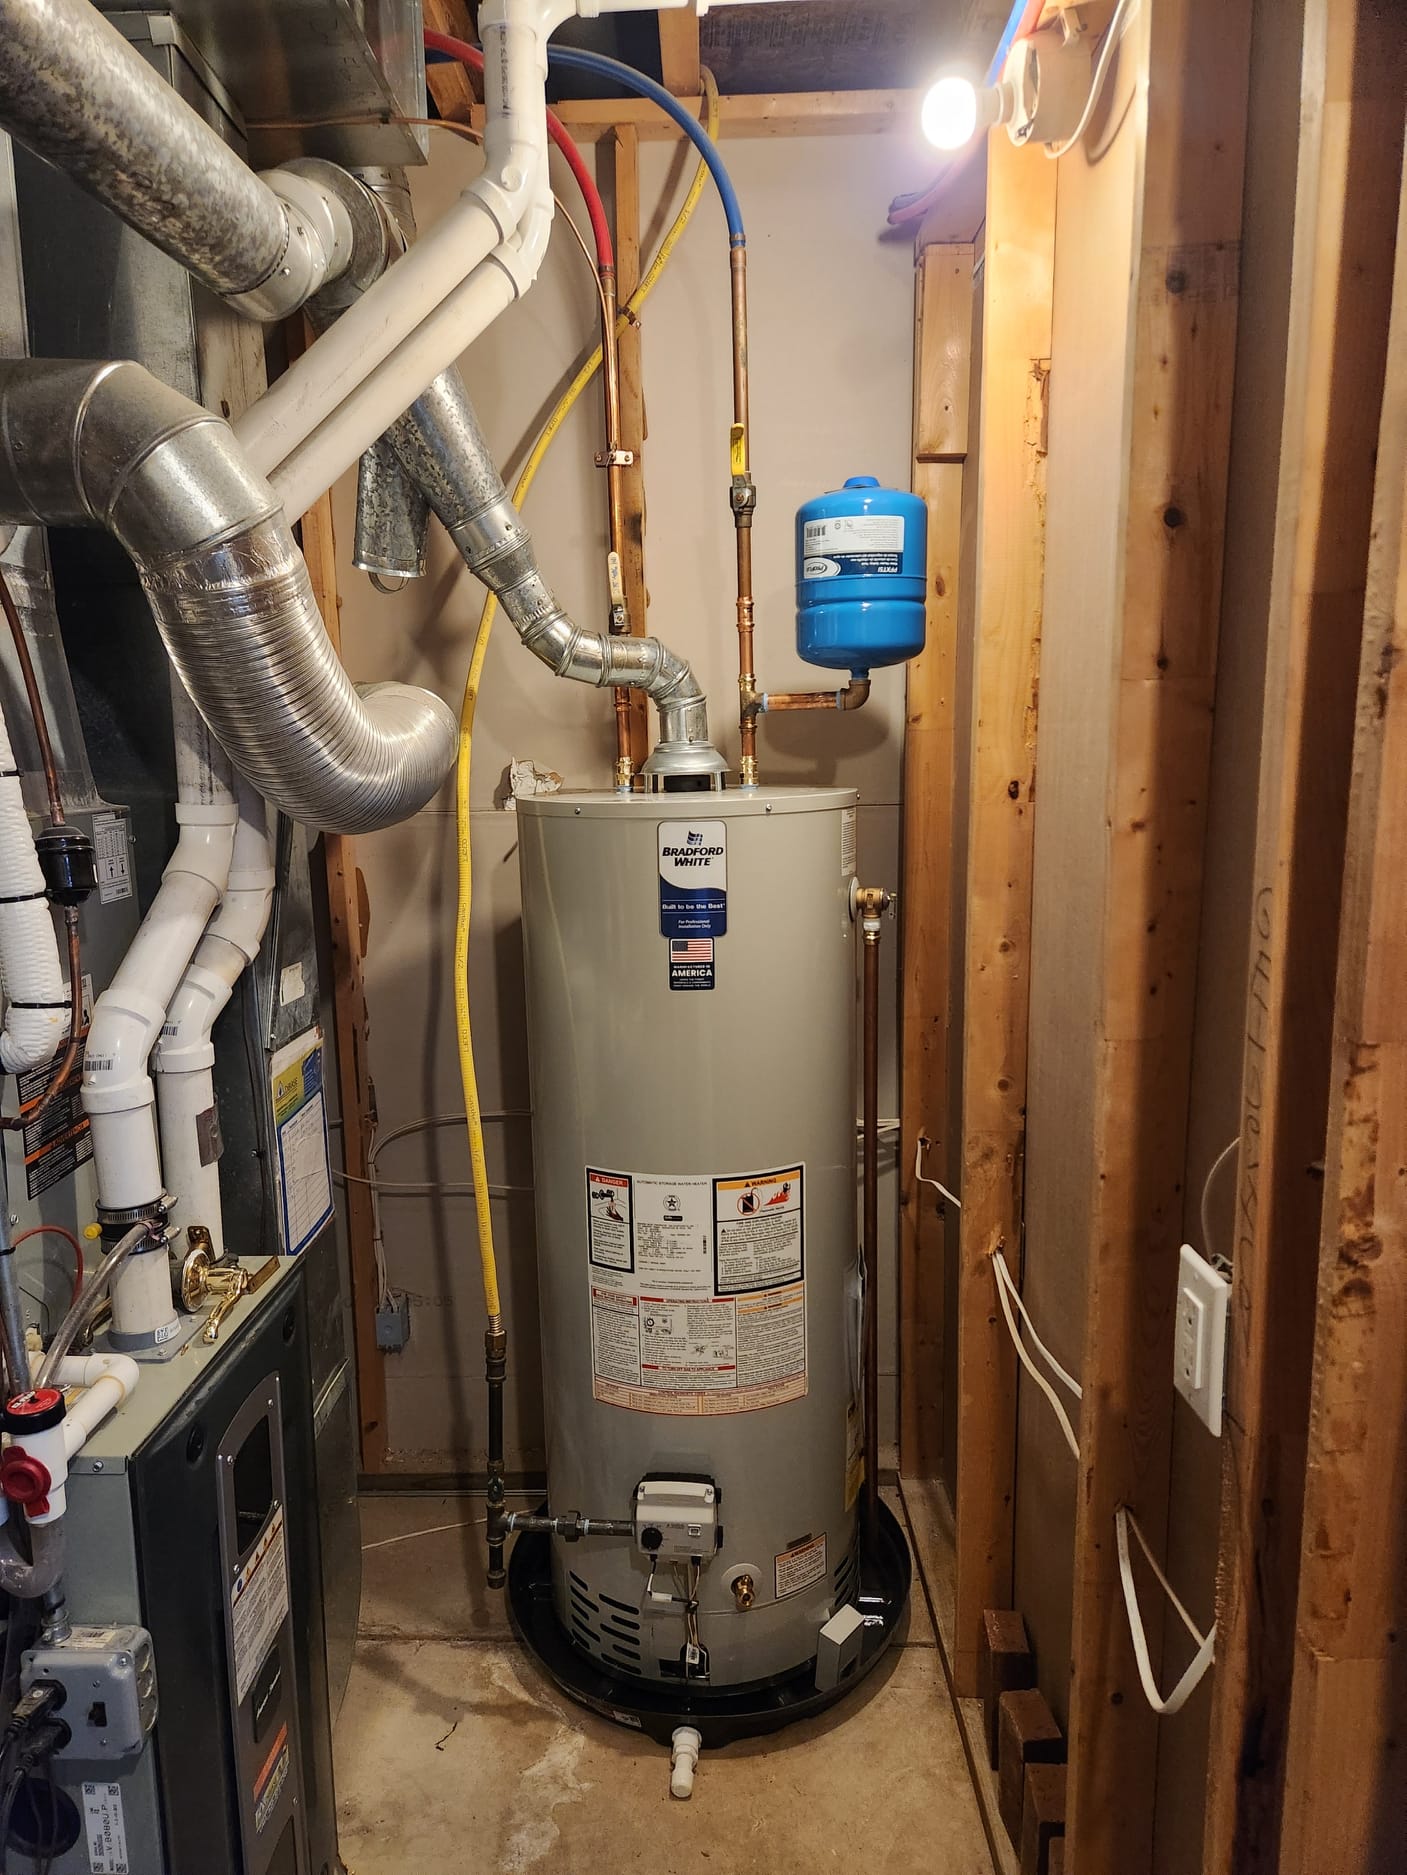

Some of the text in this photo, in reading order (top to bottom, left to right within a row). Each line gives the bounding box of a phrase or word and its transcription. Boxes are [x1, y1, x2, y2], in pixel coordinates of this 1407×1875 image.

[662, 847, 723, 856] BRADFORD
[674, 857, 711, 866] WHITE
[672, 969, 712, 977] AMERICA
[602, 1176, 624, 1186] DANGER
[751, 1178, 777, 1187] WARNING
